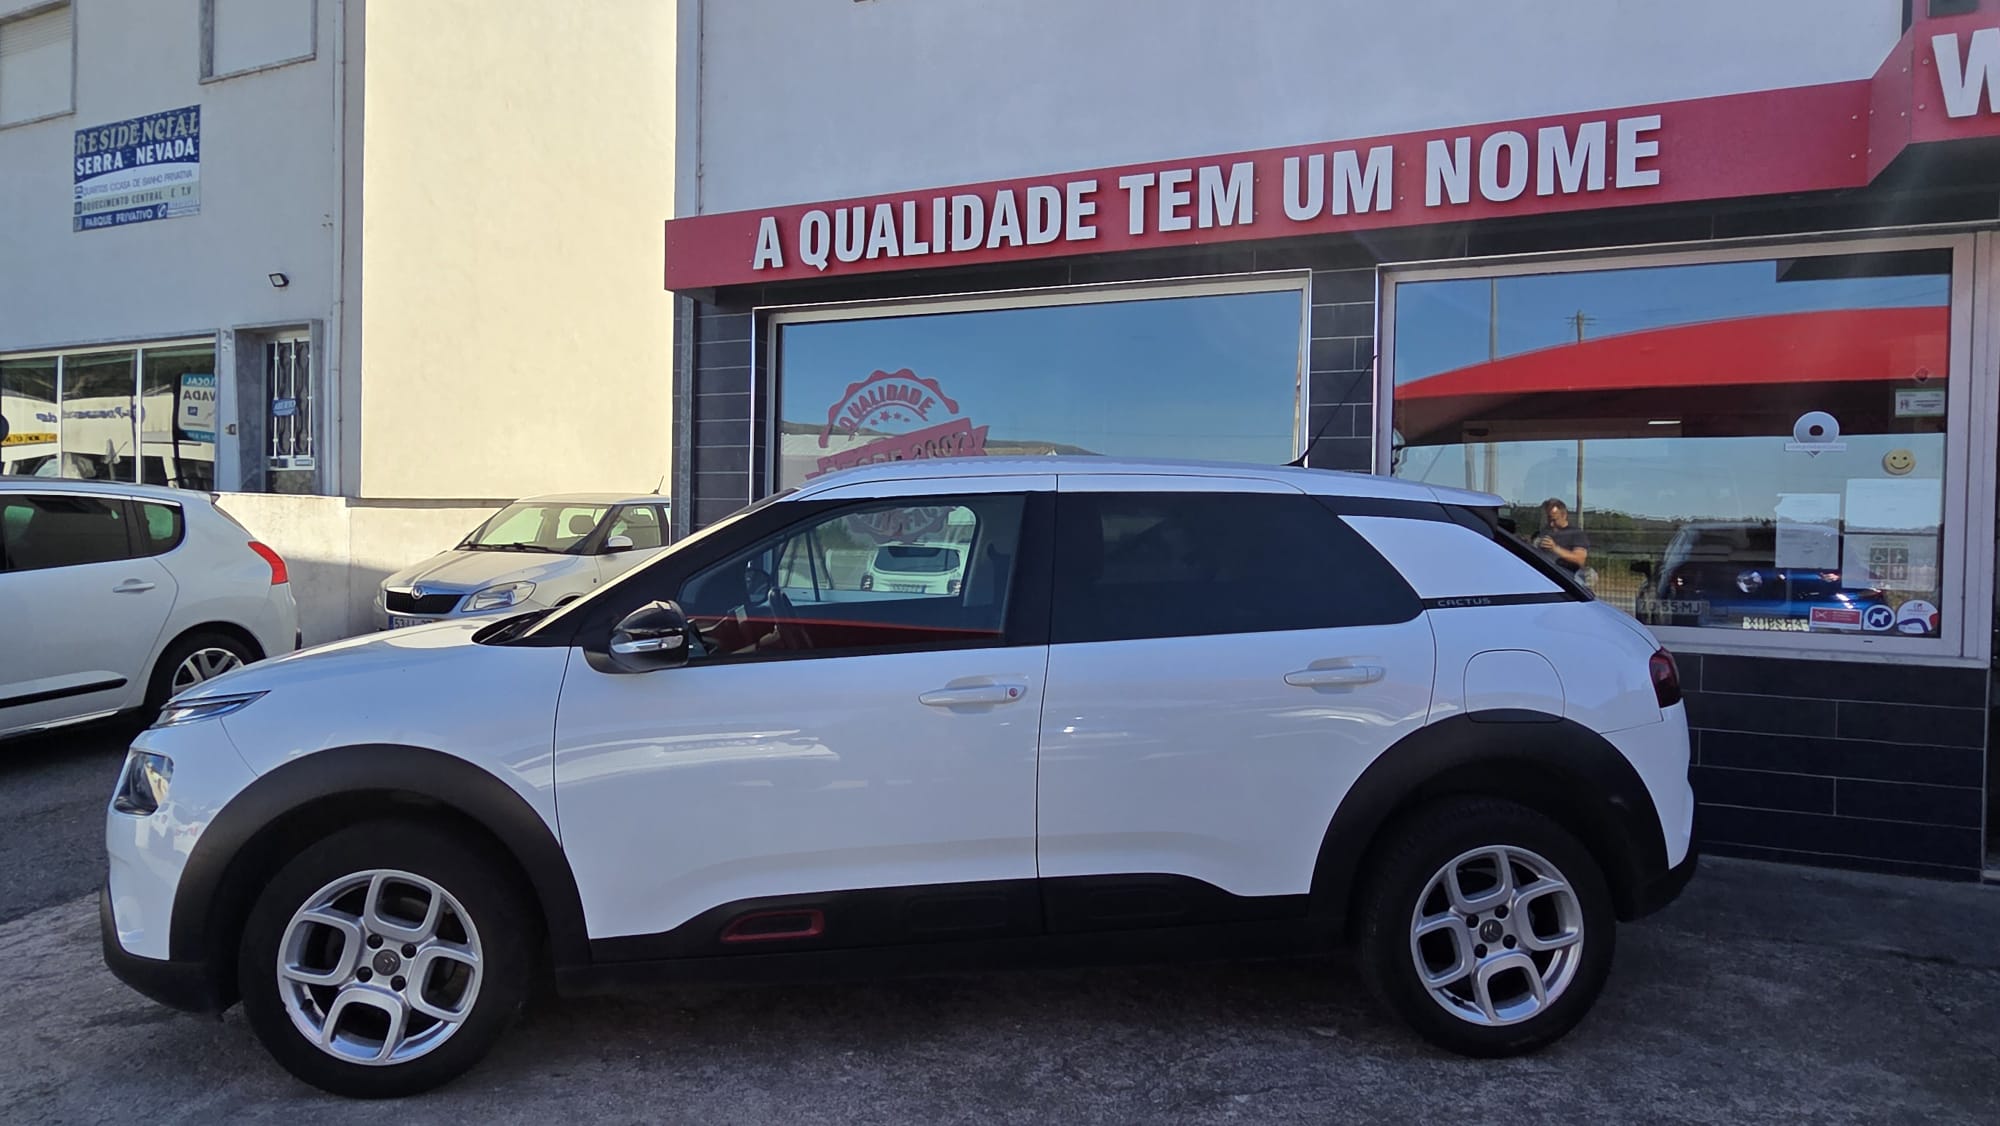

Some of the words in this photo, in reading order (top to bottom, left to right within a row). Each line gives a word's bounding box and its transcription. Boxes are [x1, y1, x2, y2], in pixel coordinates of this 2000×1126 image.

[76, 151, 124, 177] SERRA
[136, 138, 195, 166] NEVADA
[83, 196, 129, 211] AQUECIMENTO
[131, 190, 163, 204] CENTRAL
[170, 188, 175, 197] E
[753, 216, 785, 270] A
[799, 180, 1098, 272] QUALIDADE
[1119, 161, 1254, 236] TEM
[1283, 145, 1394, 222] UM
[1425, 115, 1662, 207] NOME
[85, 213, 112, 228] PARQUE
[115, 208, 153, 224] PRIVATIVO
[839, 384, 936, 441] QUALIDADE
[1437, 597, 1491, 607] CACTUS
